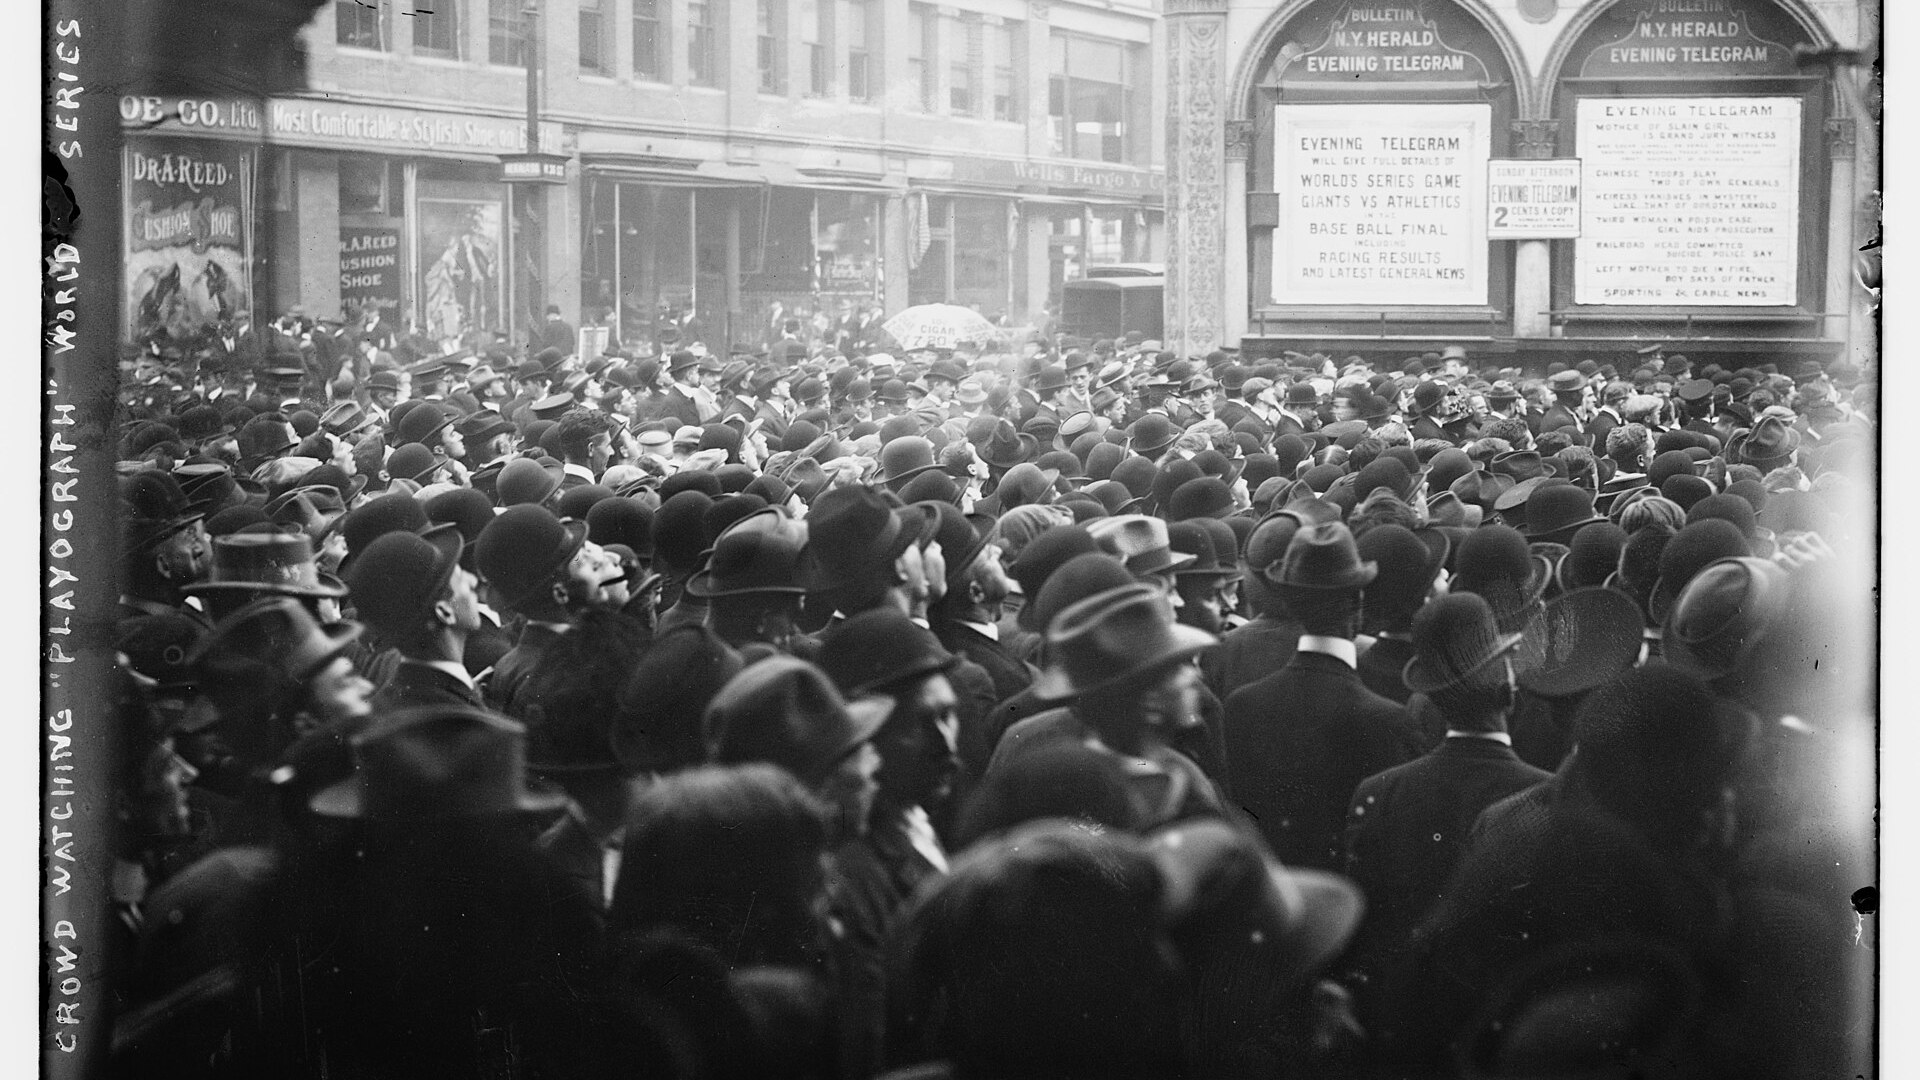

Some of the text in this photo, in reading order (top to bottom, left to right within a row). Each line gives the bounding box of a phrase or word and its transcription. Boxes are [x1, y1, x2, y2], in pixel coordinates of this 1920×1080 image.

[1351, 8, 1415, 21] BULLETIN
[1671, 23, 1739, 37] HERALD
[1367, 31, 1434, 47] HERALD
[1610, 47, 1768, 63] EVENING TELEGRAM
[1307, 55, 1464, 72] EVENING TELEGRAM
[1605, 106, 1773, 116] EVENING TELEGRAM
[272, 103, 553, 152] Most Comfortable & Stylish Shoe on Eth
[1595, 123, 1730, 131] MOTHER OF SLAIN GIRL
[1301, 137, 1460, 151] EVENING TELEGRAM
[1311, 157, 1455, 166] WILL GIVE FULL DETAILS OF
[1013, 161, 1065, 182] Wells
[1073, 167, 1124, 189] Fargo
[1595, 170, 1717, 178] CHINESE TROOPS SLAY
[1367, 174, 1415, 188] SERIES
[1425, 174, 1462, 188] GAME
[1491, 184, 1578, 203] EVENING TELEGRAM
[1301, 195, 1461, 209] GIANTS VS ATHLETICS
[1494, 206, 1508, 228] 2
[1511, 206, 1540, 216] CENTS
[1551, 206, 1574, 216] COPY
[1595, 216, 1625, 224] THIRD
[1633, 216, 1669, 224] WOMAN
[1673, 216, 1683, 224] IN
[1688, 216, 1723, 224] POISON
[1309, 223, 1448, 236] BASE BALL FINAL
[1354, 240, 1406, 248] INCLUDING
[1319, 251, 1441, 264] RACING RESULTS
[1302, 267, 1465, 279] AND LATEST GENERAL NEWS
[1665, 275, 1775, 283] BOY SAYS OF FATHER
[341, 273, 382, 289] SHOE
[1604, 289, 1662, 298] SPORTING
[1694, 289, 1730, 298] CABLE
[1737, 289, 1767, 298] NEWS
[921, 324, 956, 336] CIGAR
